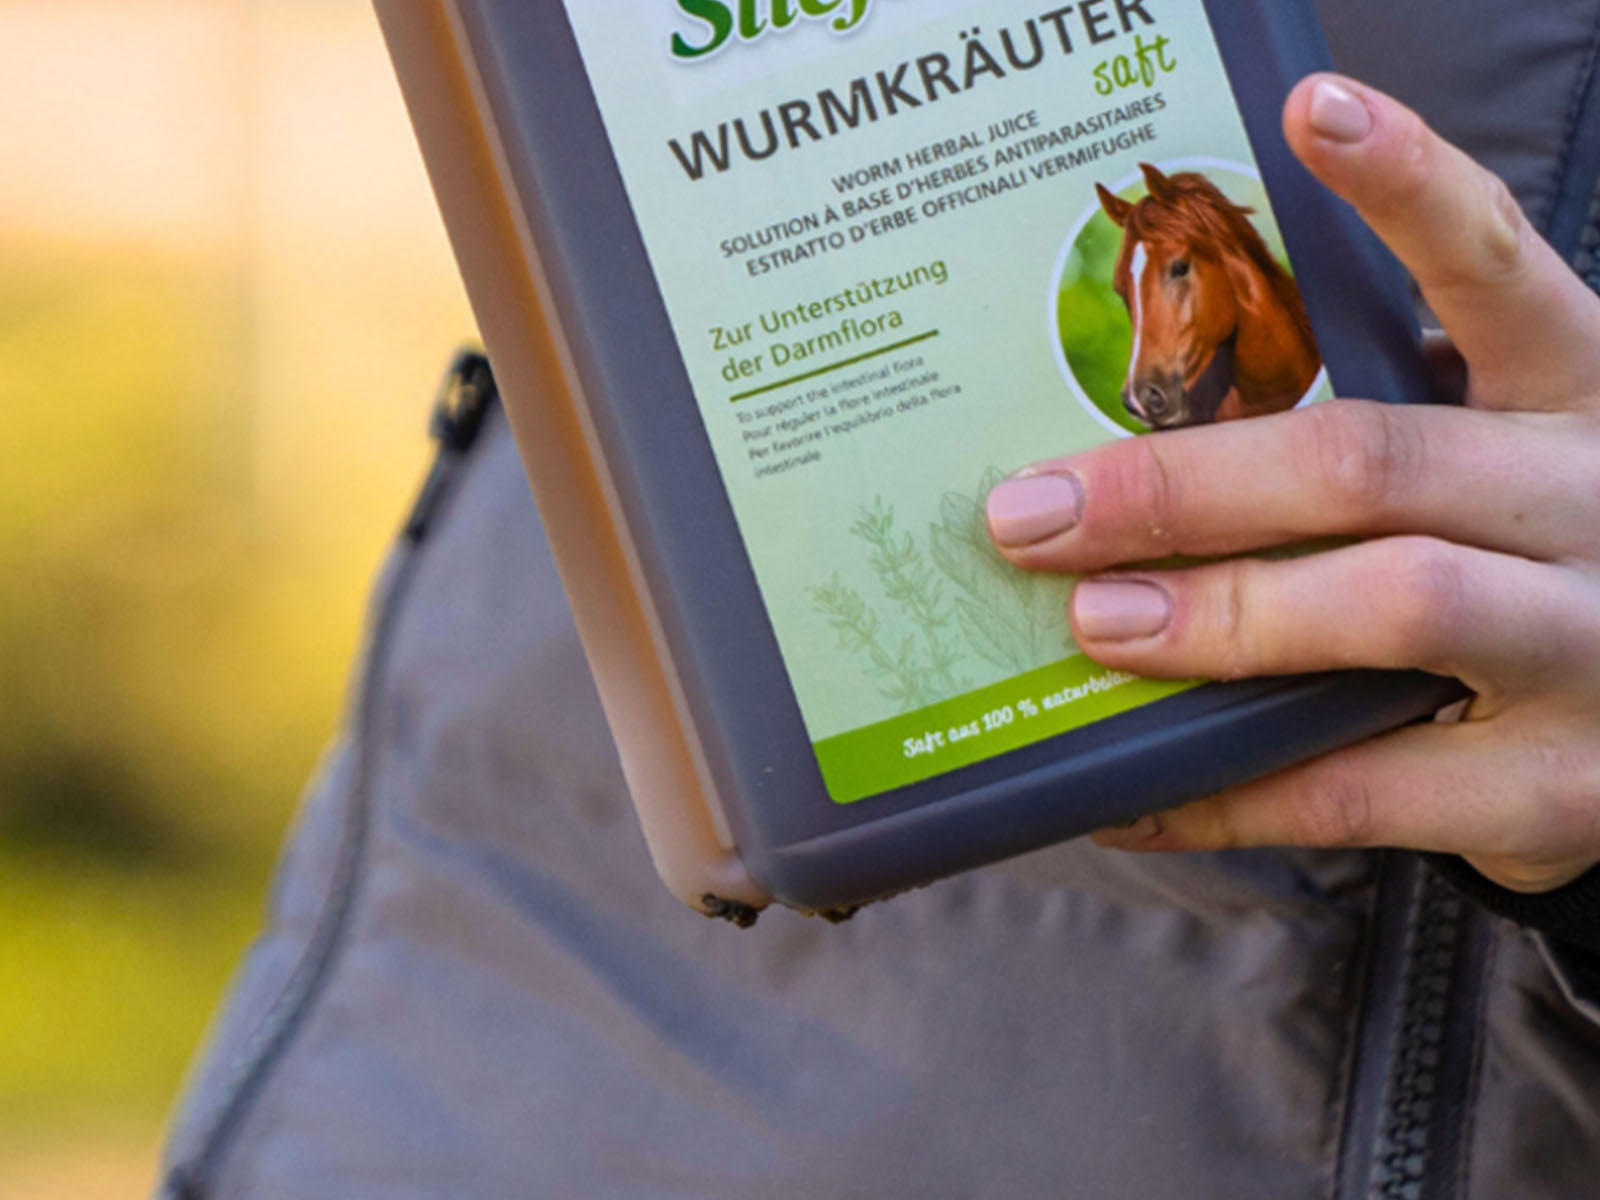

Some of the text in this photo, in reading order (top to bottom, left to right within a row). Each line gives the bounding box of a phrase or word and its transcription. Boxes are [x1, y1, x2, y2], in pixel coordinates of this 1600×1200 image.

[1092, 34, 1177, 96] saft
[719, 92, 1167, 259] SOLUTION À BASE D'HERBES ANTIPARASITAIRES
[831, 109, 1040, 194] WORM HERBAL JUICE
[746, 123, 1157, 277] ESTRATTO D'ERBE OFFICINALI VERMIFUGHE
[708, 259, 949, 352] Zur Unterstützung
[720, 308, 904, 382] der Darmflora
[736, 411, 753, 424] To
[755, 395, 804, 419] support
[806, 387, 829, 402] the
[831, 365, 890, 395] intestinal
[748, 445, 769, 460] Per
[773, 431, 822, 452] favorire
[896, 394, 929, 413] della
[742, 426, 771, 443] Pour
[754, 449, 821, 479] intestinale
[902, 731, 945, 757] Saft
[982, 705, 1014, 731] 100
[1017, 701, 1038, 718] %
